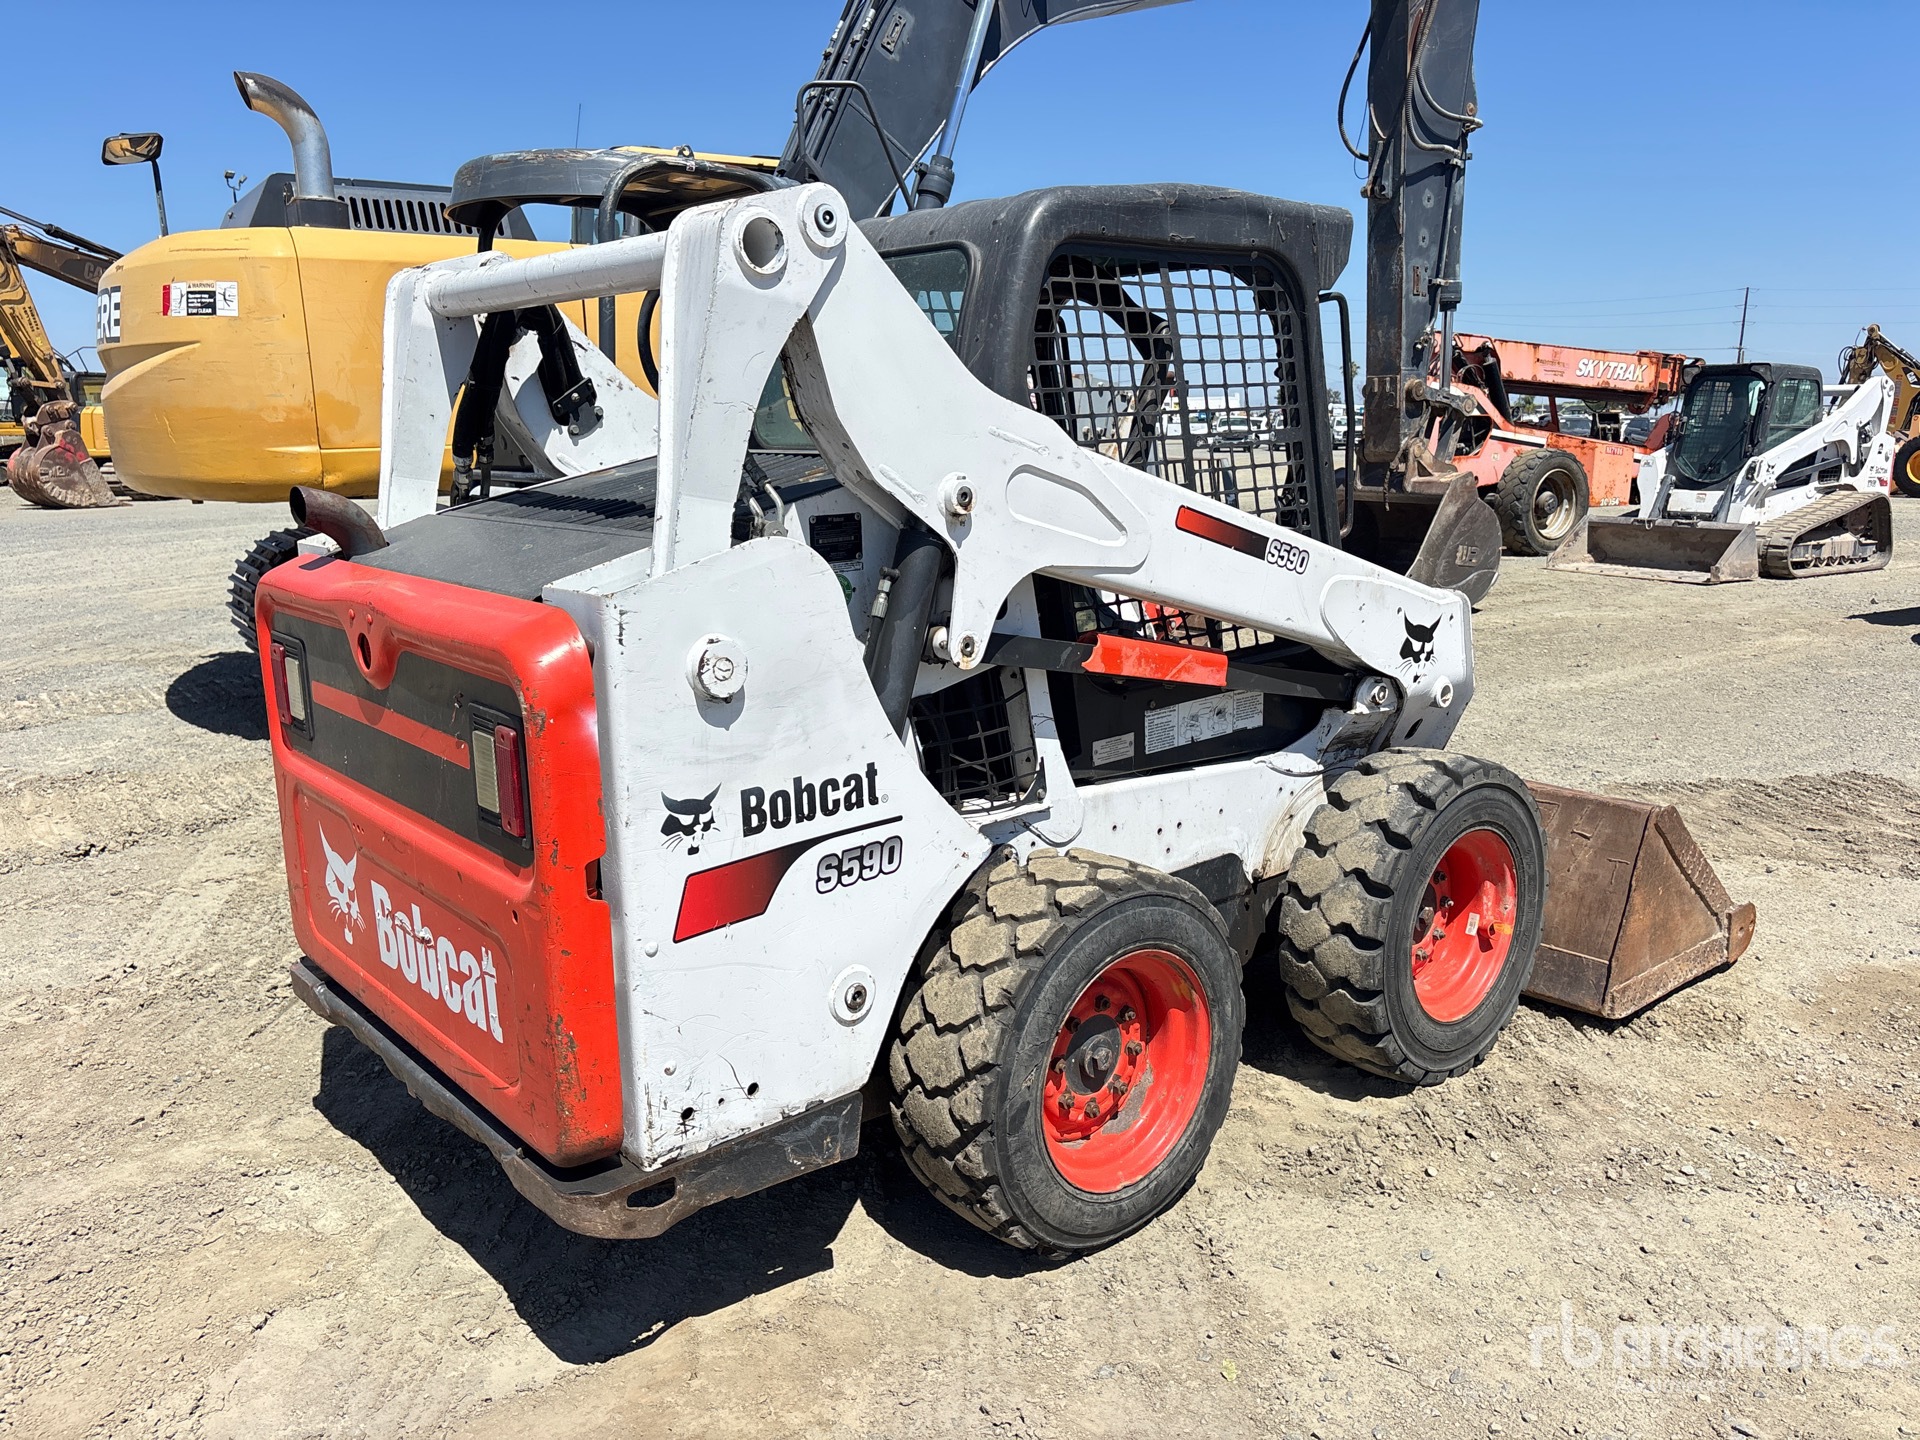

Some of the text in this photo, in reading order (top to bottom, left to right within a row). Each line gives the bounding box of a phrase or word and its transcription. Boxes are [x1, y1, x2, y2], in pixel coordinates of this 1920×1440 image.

[1575, 358, 1648, 382] SKYTRAK
[1266, 538, 1310, 575] S590
[740, 761, 879, 838] Bobcat
[816, 835, 903, 894] S590
[371, 879, 504, 1043] Bobcat
